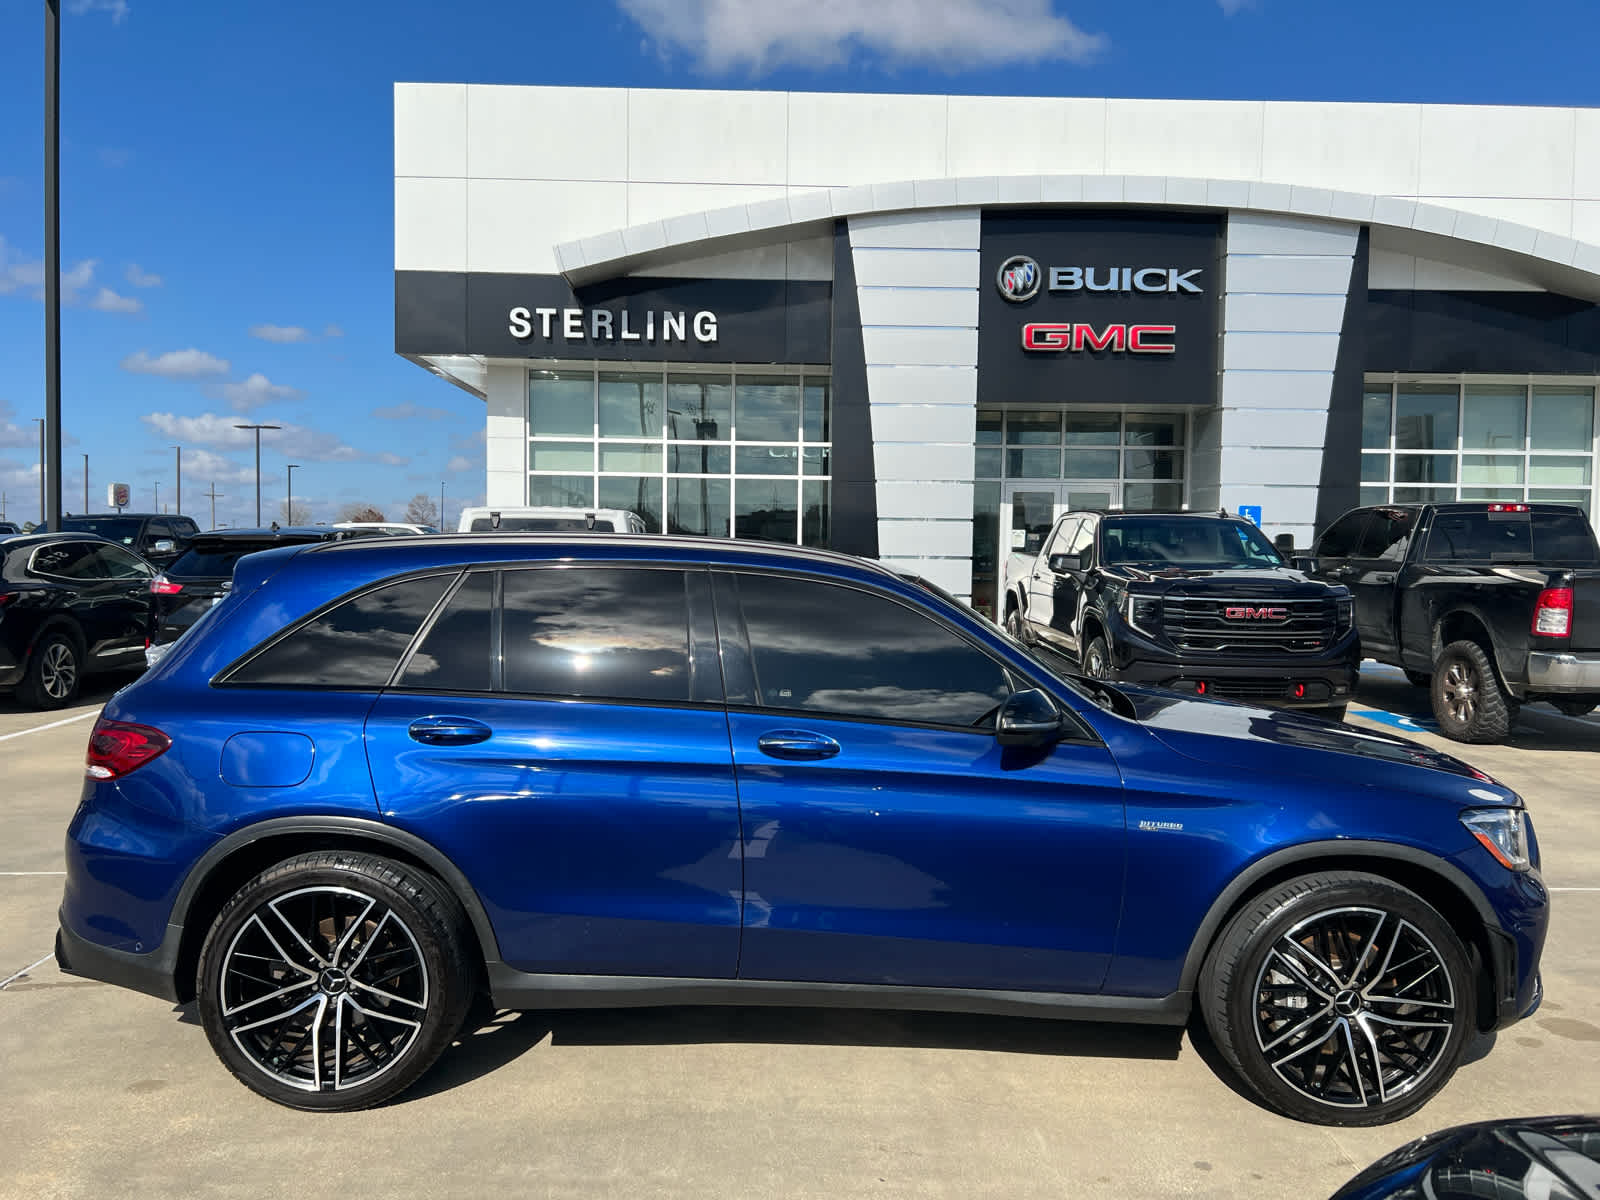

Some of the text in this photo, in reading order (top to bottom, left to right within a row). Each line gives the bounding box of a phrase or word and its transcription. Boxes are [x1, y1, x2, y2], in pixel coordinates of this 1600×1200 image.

[1049, 266, 1204, 293] BUICK
[508, 307, 718, 342] STERLING
[1022, 322, 1177, 354] GMC
[1225, 607, 1288, 620] GMC
